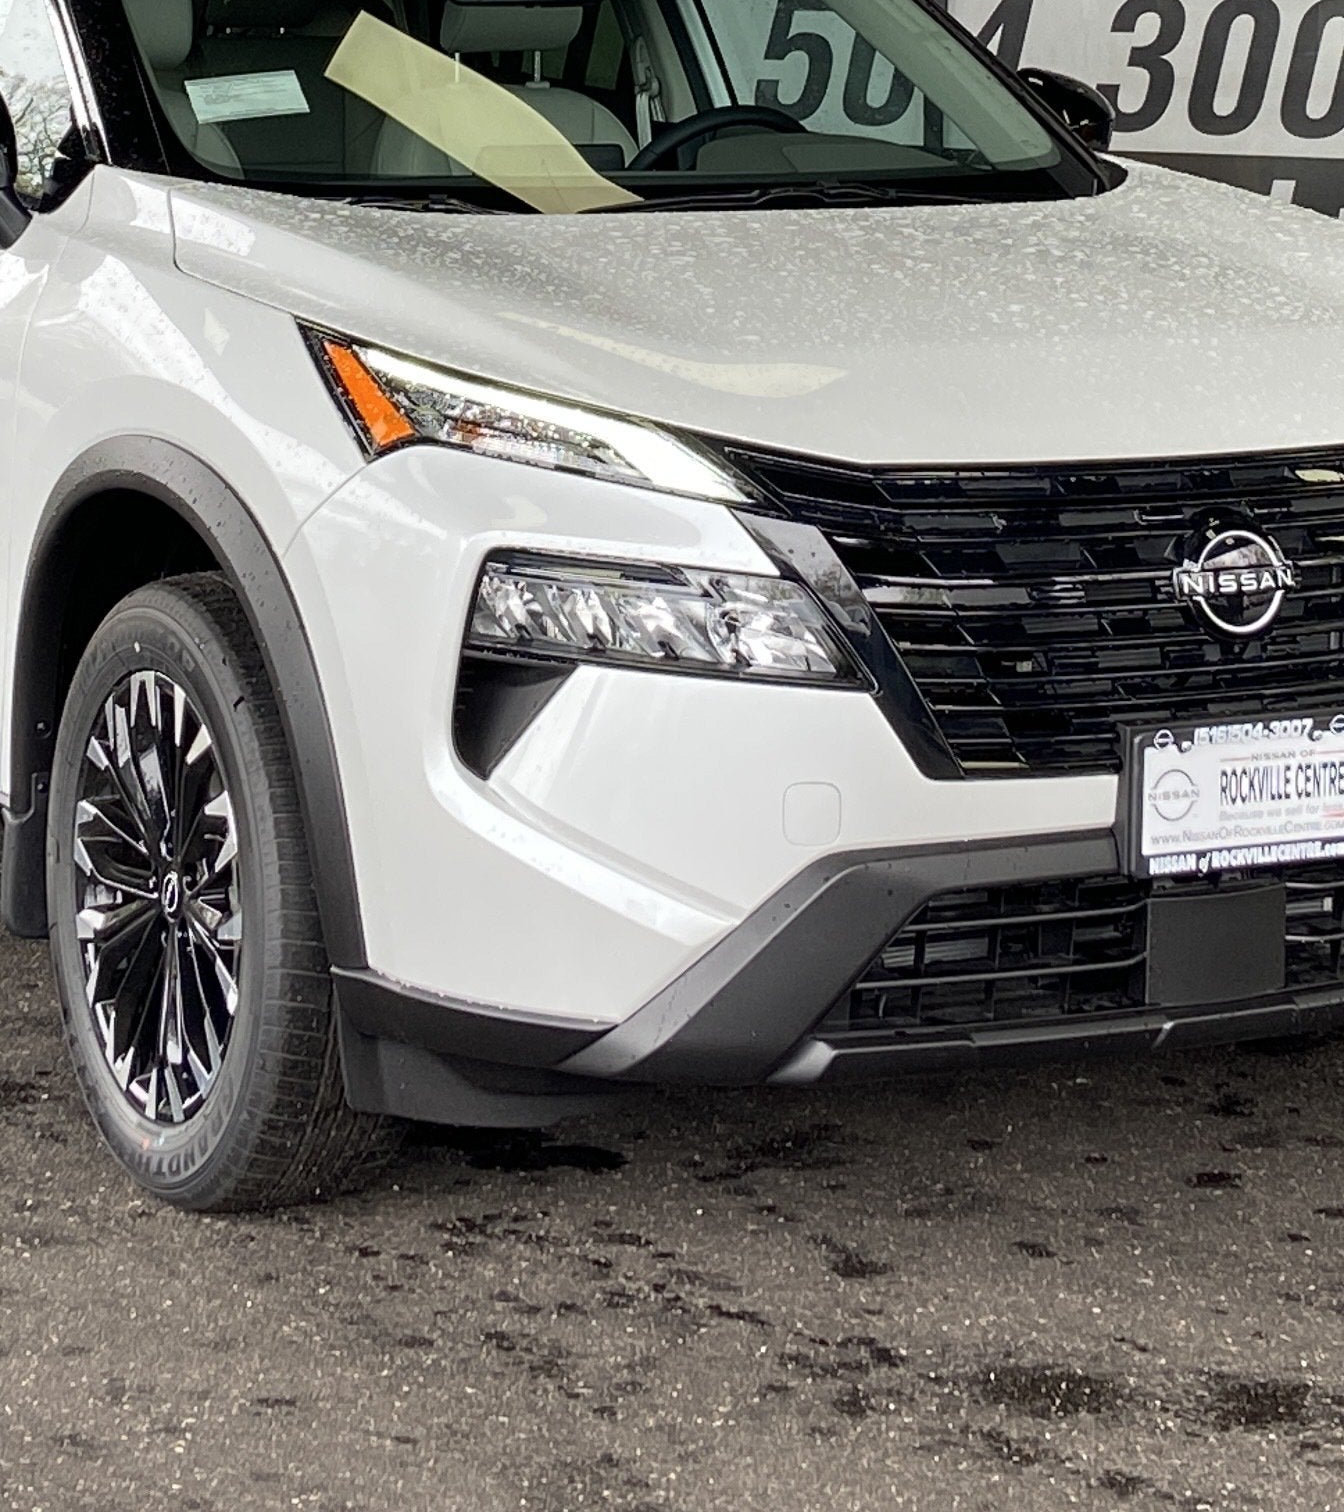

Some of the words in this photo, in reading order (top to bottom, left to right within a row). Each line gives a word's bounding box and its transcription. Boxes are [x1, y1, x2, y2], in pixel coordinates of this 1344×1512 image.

[1182, 568, 1296, 594] NISSAN
[1250, 752, 1296, 761] NISSAN
[1147, 788, 1201, 802] NISSAN
[1220, 764, 1291, 807] ROCKVILLE
[1149, 854, 1197, 875] NISSAN
[1198, 852, 1212, 877] of
